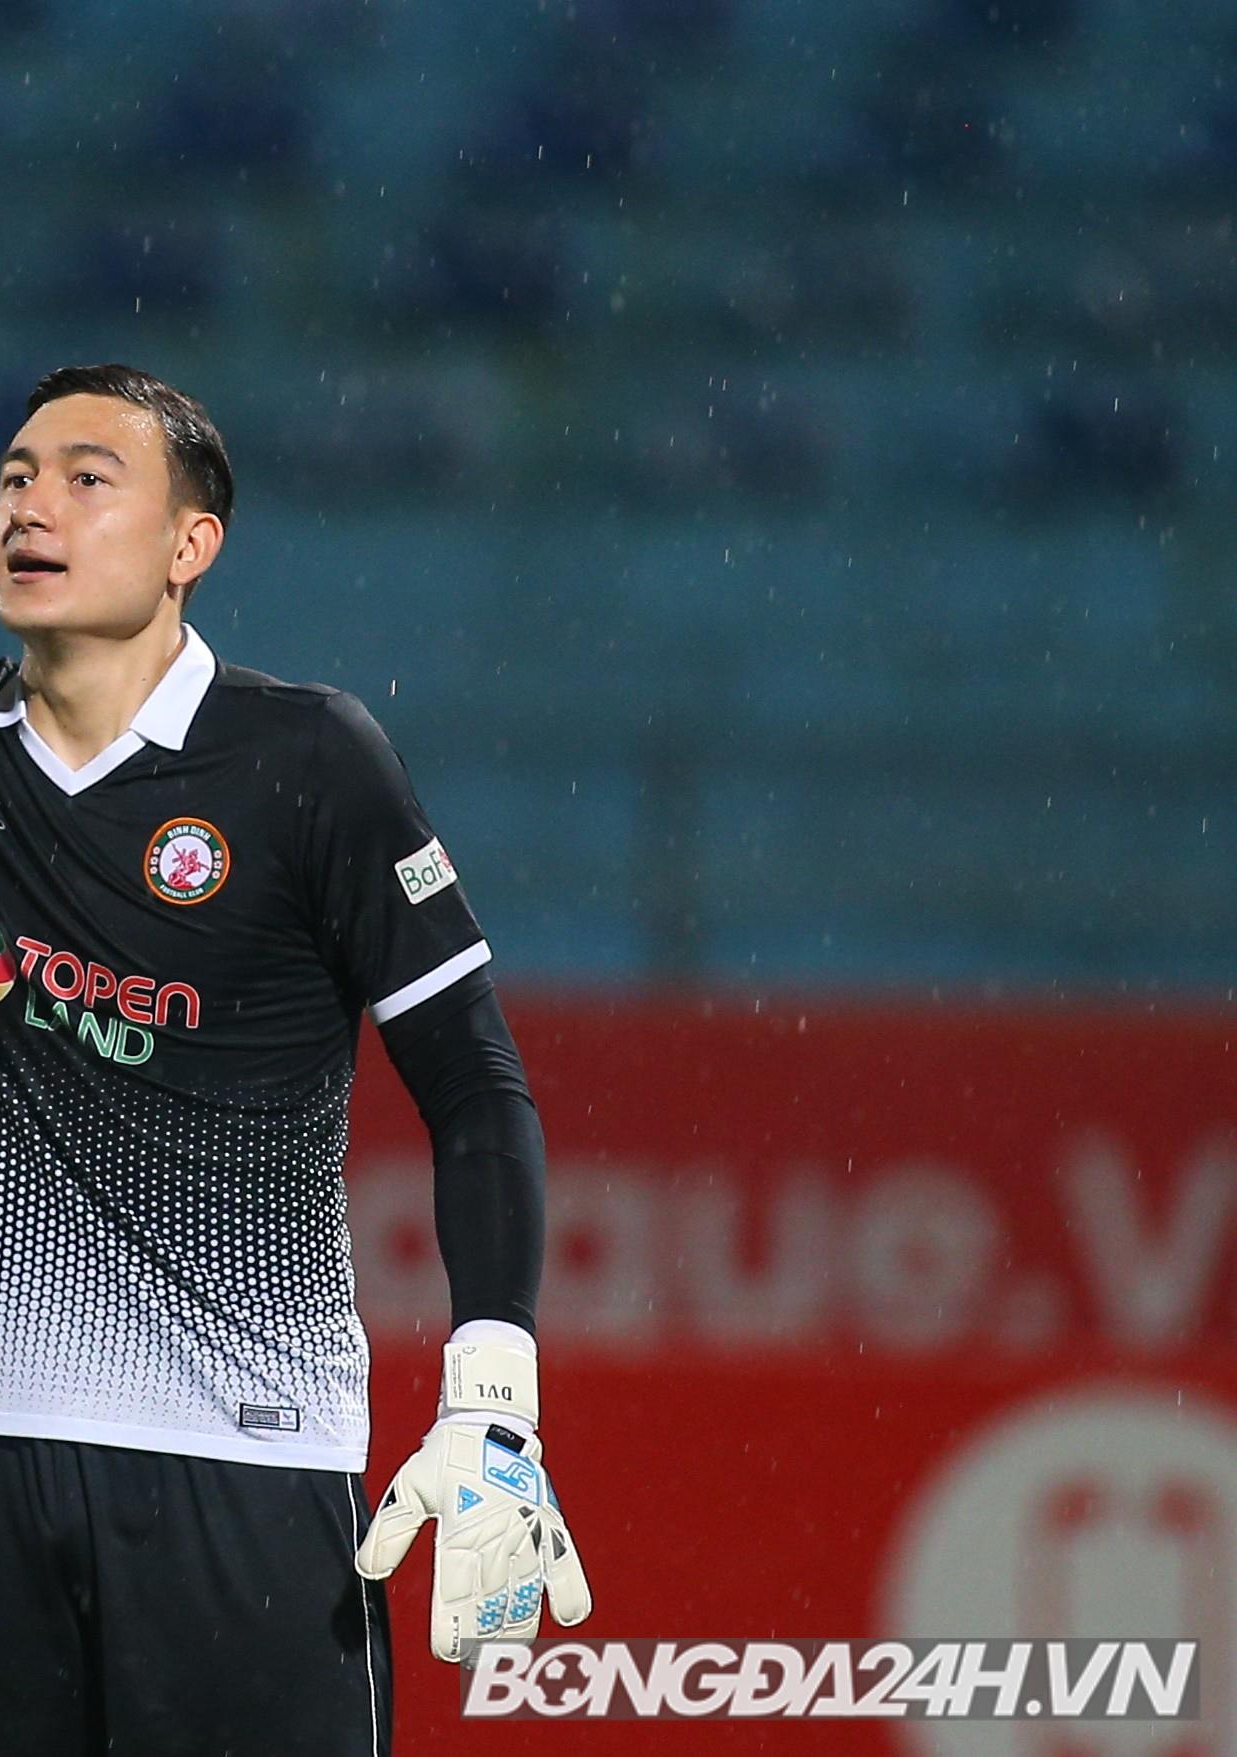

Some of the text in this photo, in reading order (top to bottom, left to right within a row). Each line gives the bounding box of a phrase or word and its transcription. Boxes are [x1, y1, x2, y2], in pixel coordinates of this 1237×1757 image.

[15, 936, 200, 1029] TOPEN
[23, 983, 155, 1066] LAND
[475, 1384, 513, 1401] DVL
